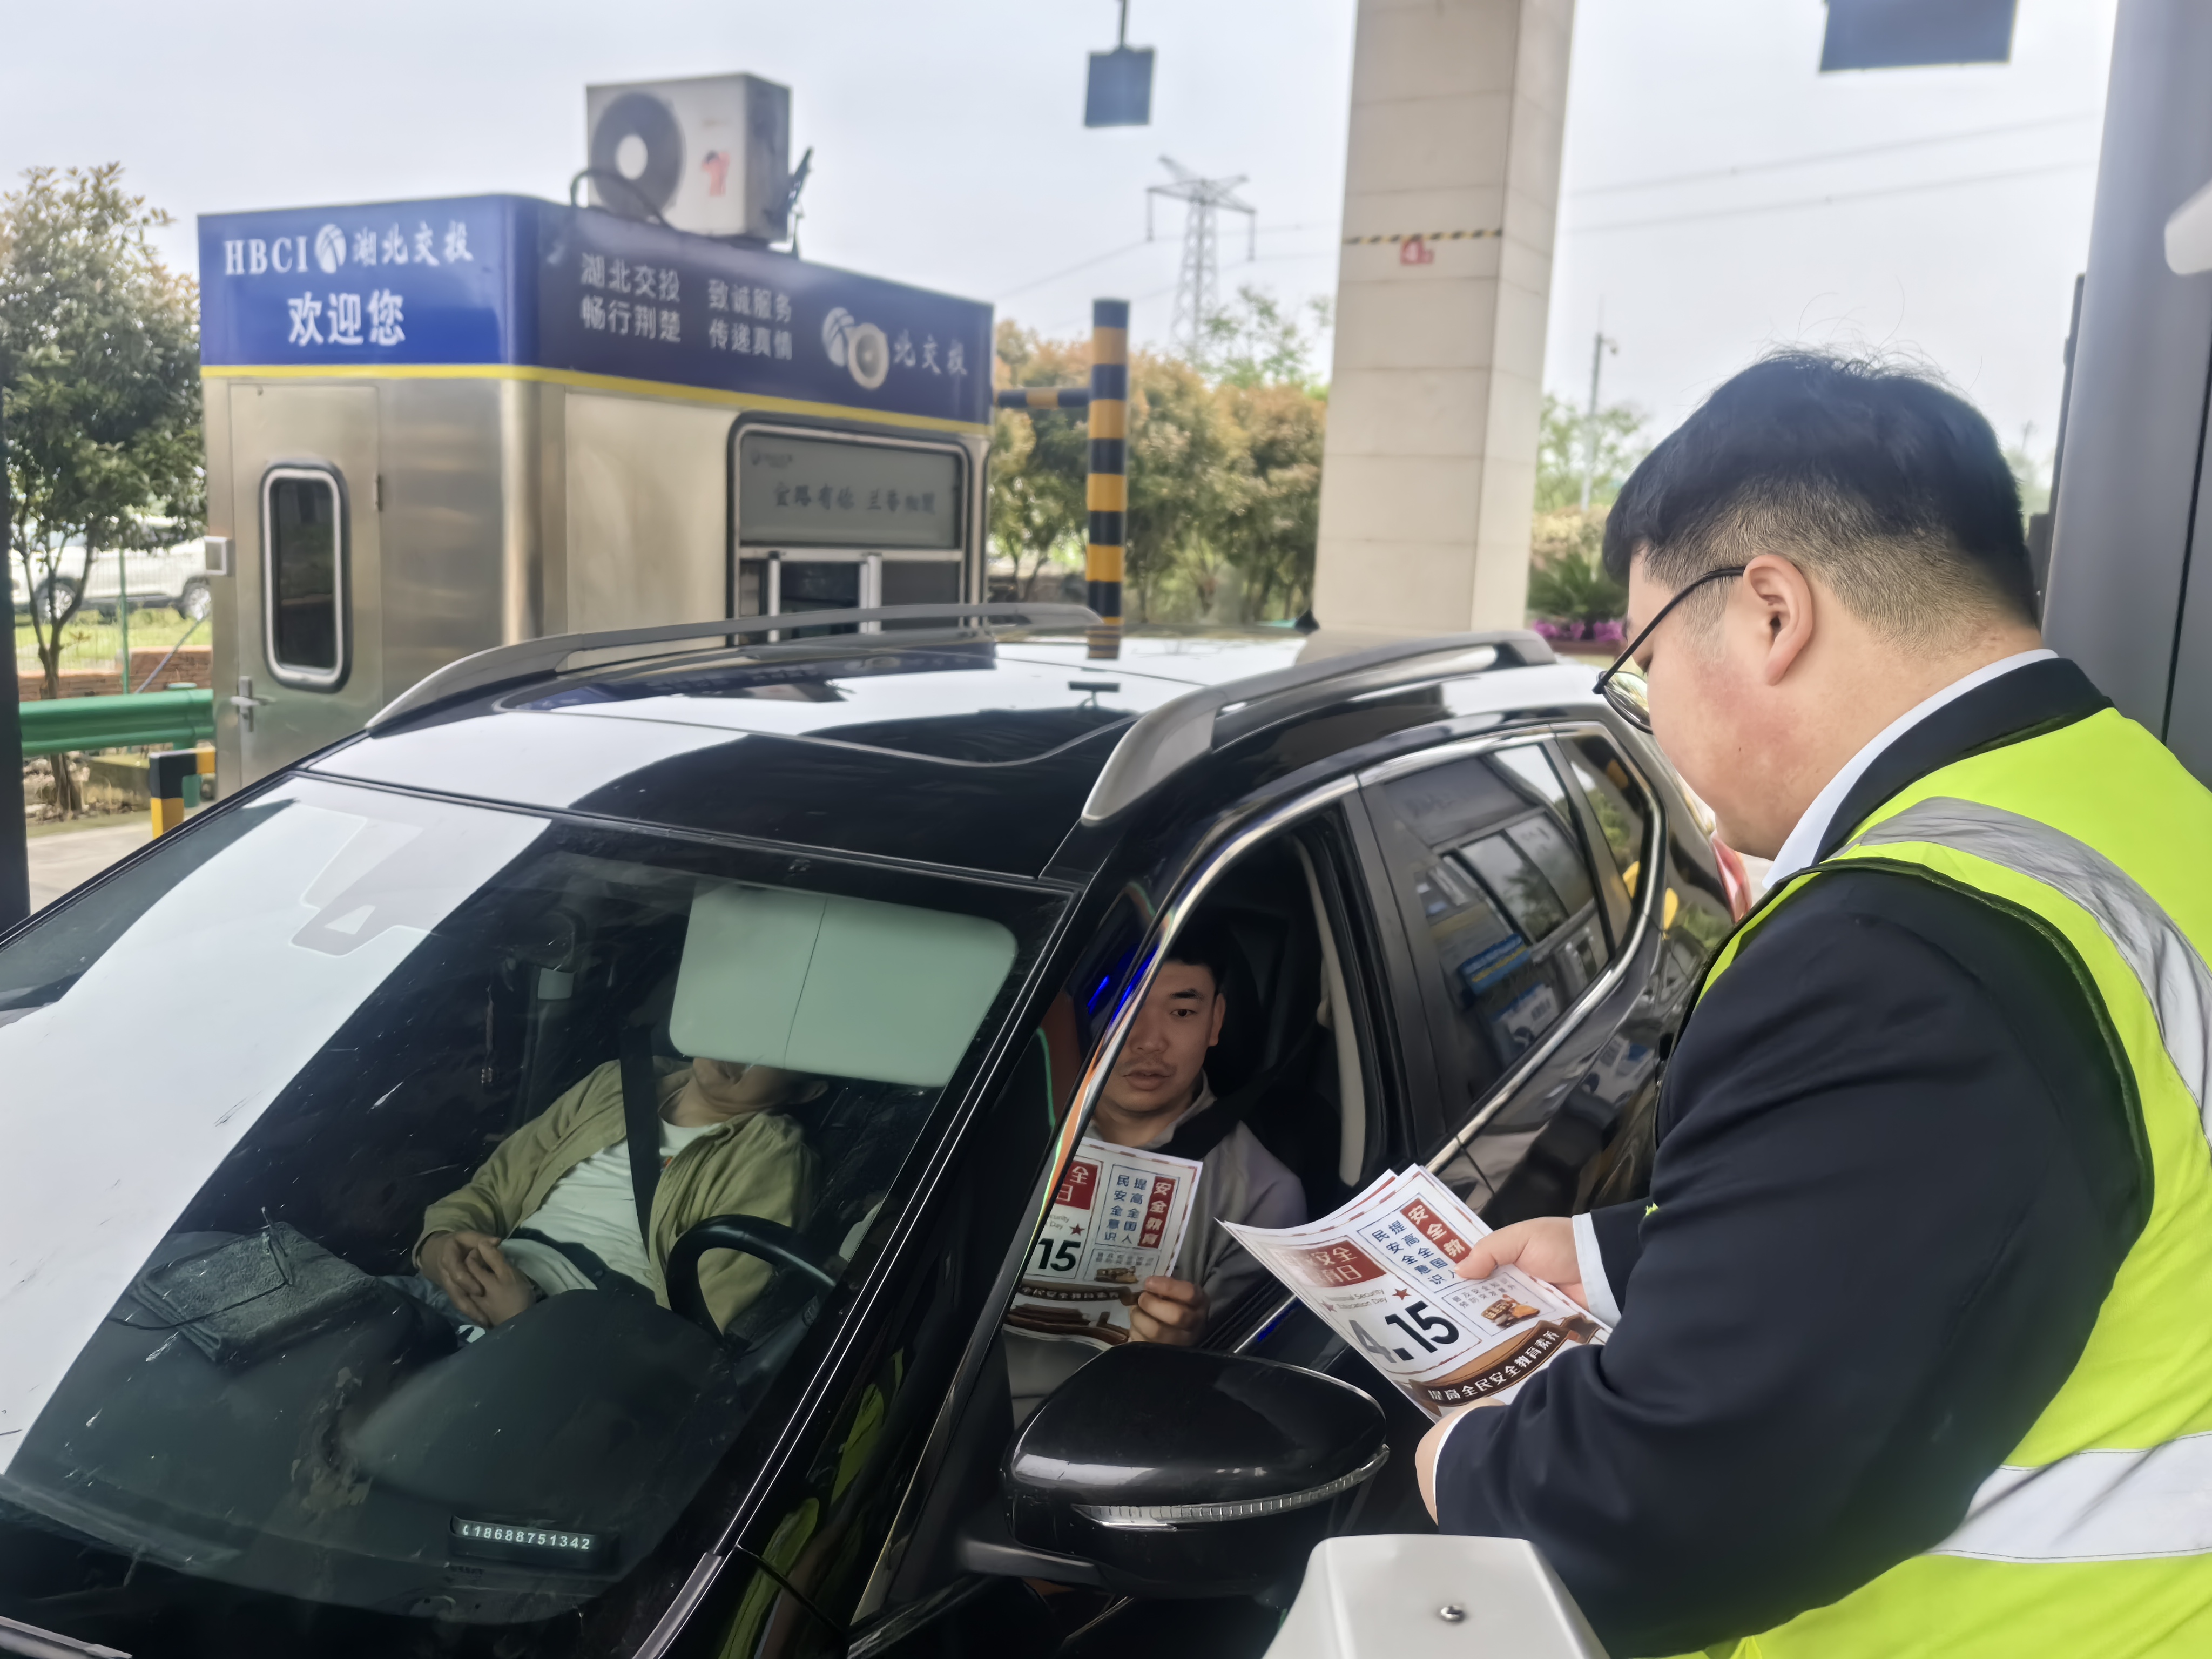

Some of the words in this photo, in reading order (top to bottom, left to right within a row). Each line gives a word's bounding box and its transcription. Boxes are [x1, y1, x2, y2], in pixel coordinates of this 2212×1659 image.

[224, 235, 308, 276] HBCI
[353, 220, 474, 267] 湖北交投
[581, 252, 680, 302] 湖北交投
[287, 288, 406, 347] 欢迎您
[580, 294, 682, 343] 畅行荆楚
[892, 328, 968, 375] 北交投
[1372, 1229, 1447, 1285] 民安全意识
[1408, 1204, 1465, 1258] 安全教
[1428, 1330, 1560, 1401] 提高全民安全教育素养
[474, 1526, 590, 1550] 18688751342
